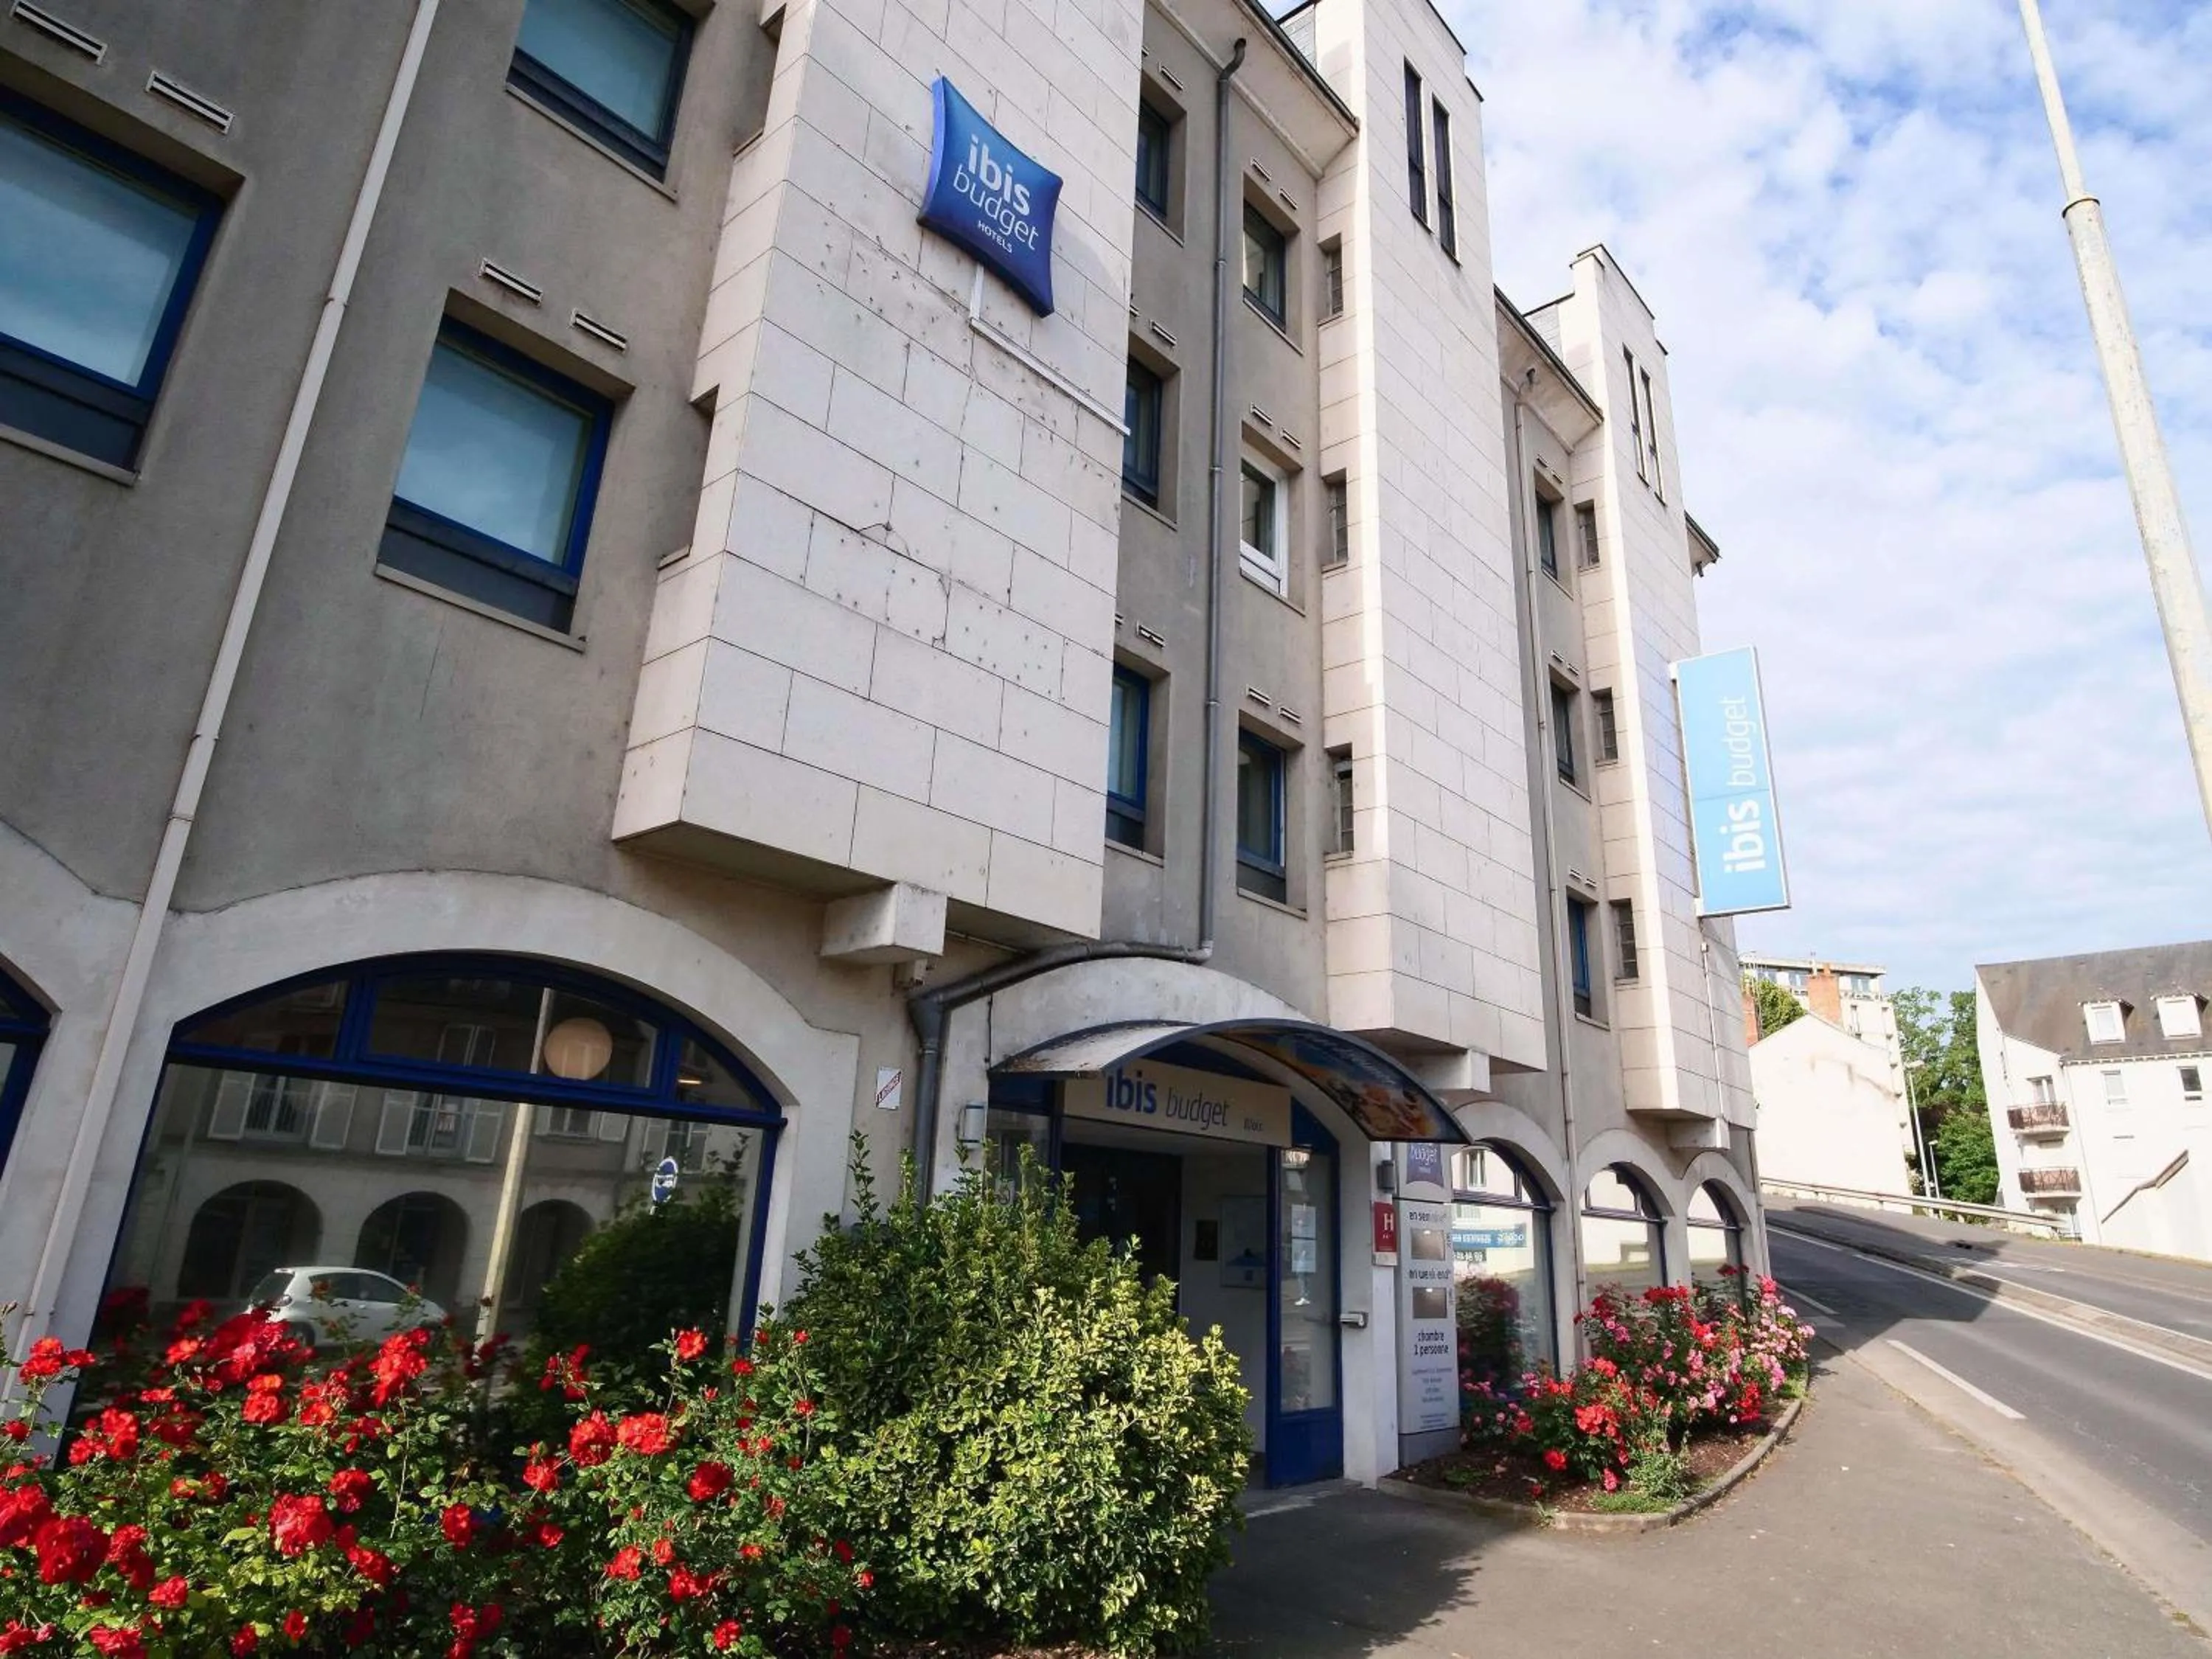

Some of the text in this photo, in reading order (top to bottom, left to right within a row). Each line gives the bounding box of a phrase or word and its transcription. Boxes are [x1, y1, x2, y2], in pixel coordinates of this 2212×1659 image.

[953, 164, 1039, 250] budget
[968, 134, 1031, 215] ibis
[978, 220, 1013, 253] HOTELS
[1719, 695, 1765, 872] ibis budget
[1107, 1067, 1157, 1113] ibis
[1165, 1087, 1229, 1130] budget
[1383, 1213, 1394, 1232] H
